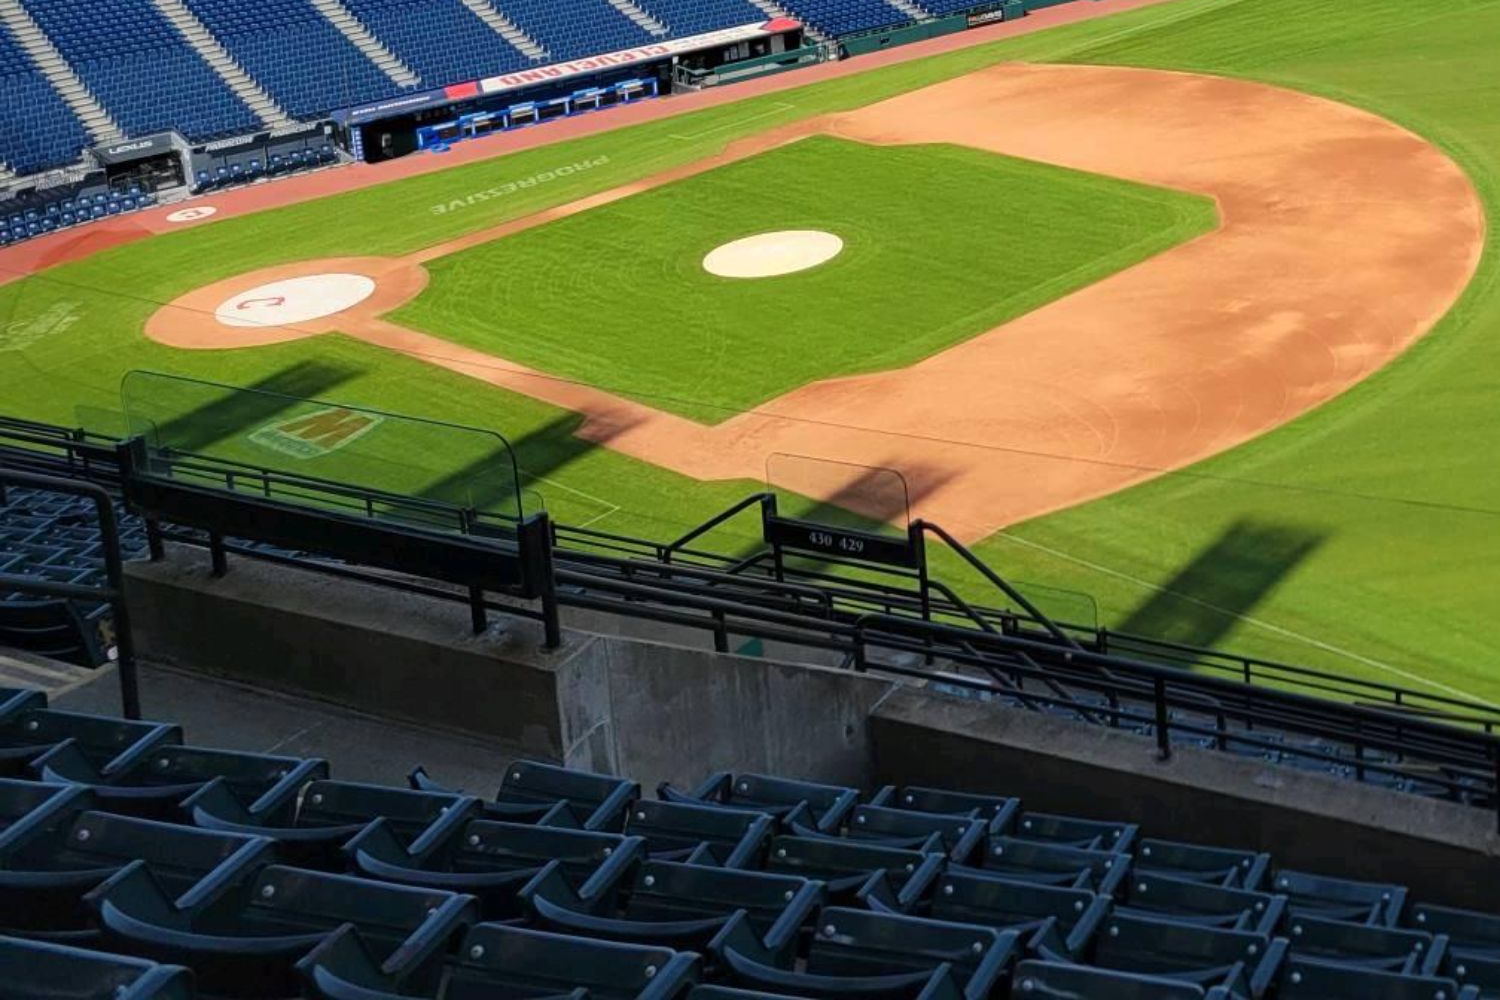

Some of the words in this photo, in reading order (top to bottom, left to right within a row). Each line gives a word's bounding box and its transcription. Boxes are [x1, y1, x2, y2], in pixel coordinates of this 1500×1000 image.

[109, 140, 152, 154] LEXUS
[809, 531, 833, 546] 430
[839, 537, 864, 551] 429
